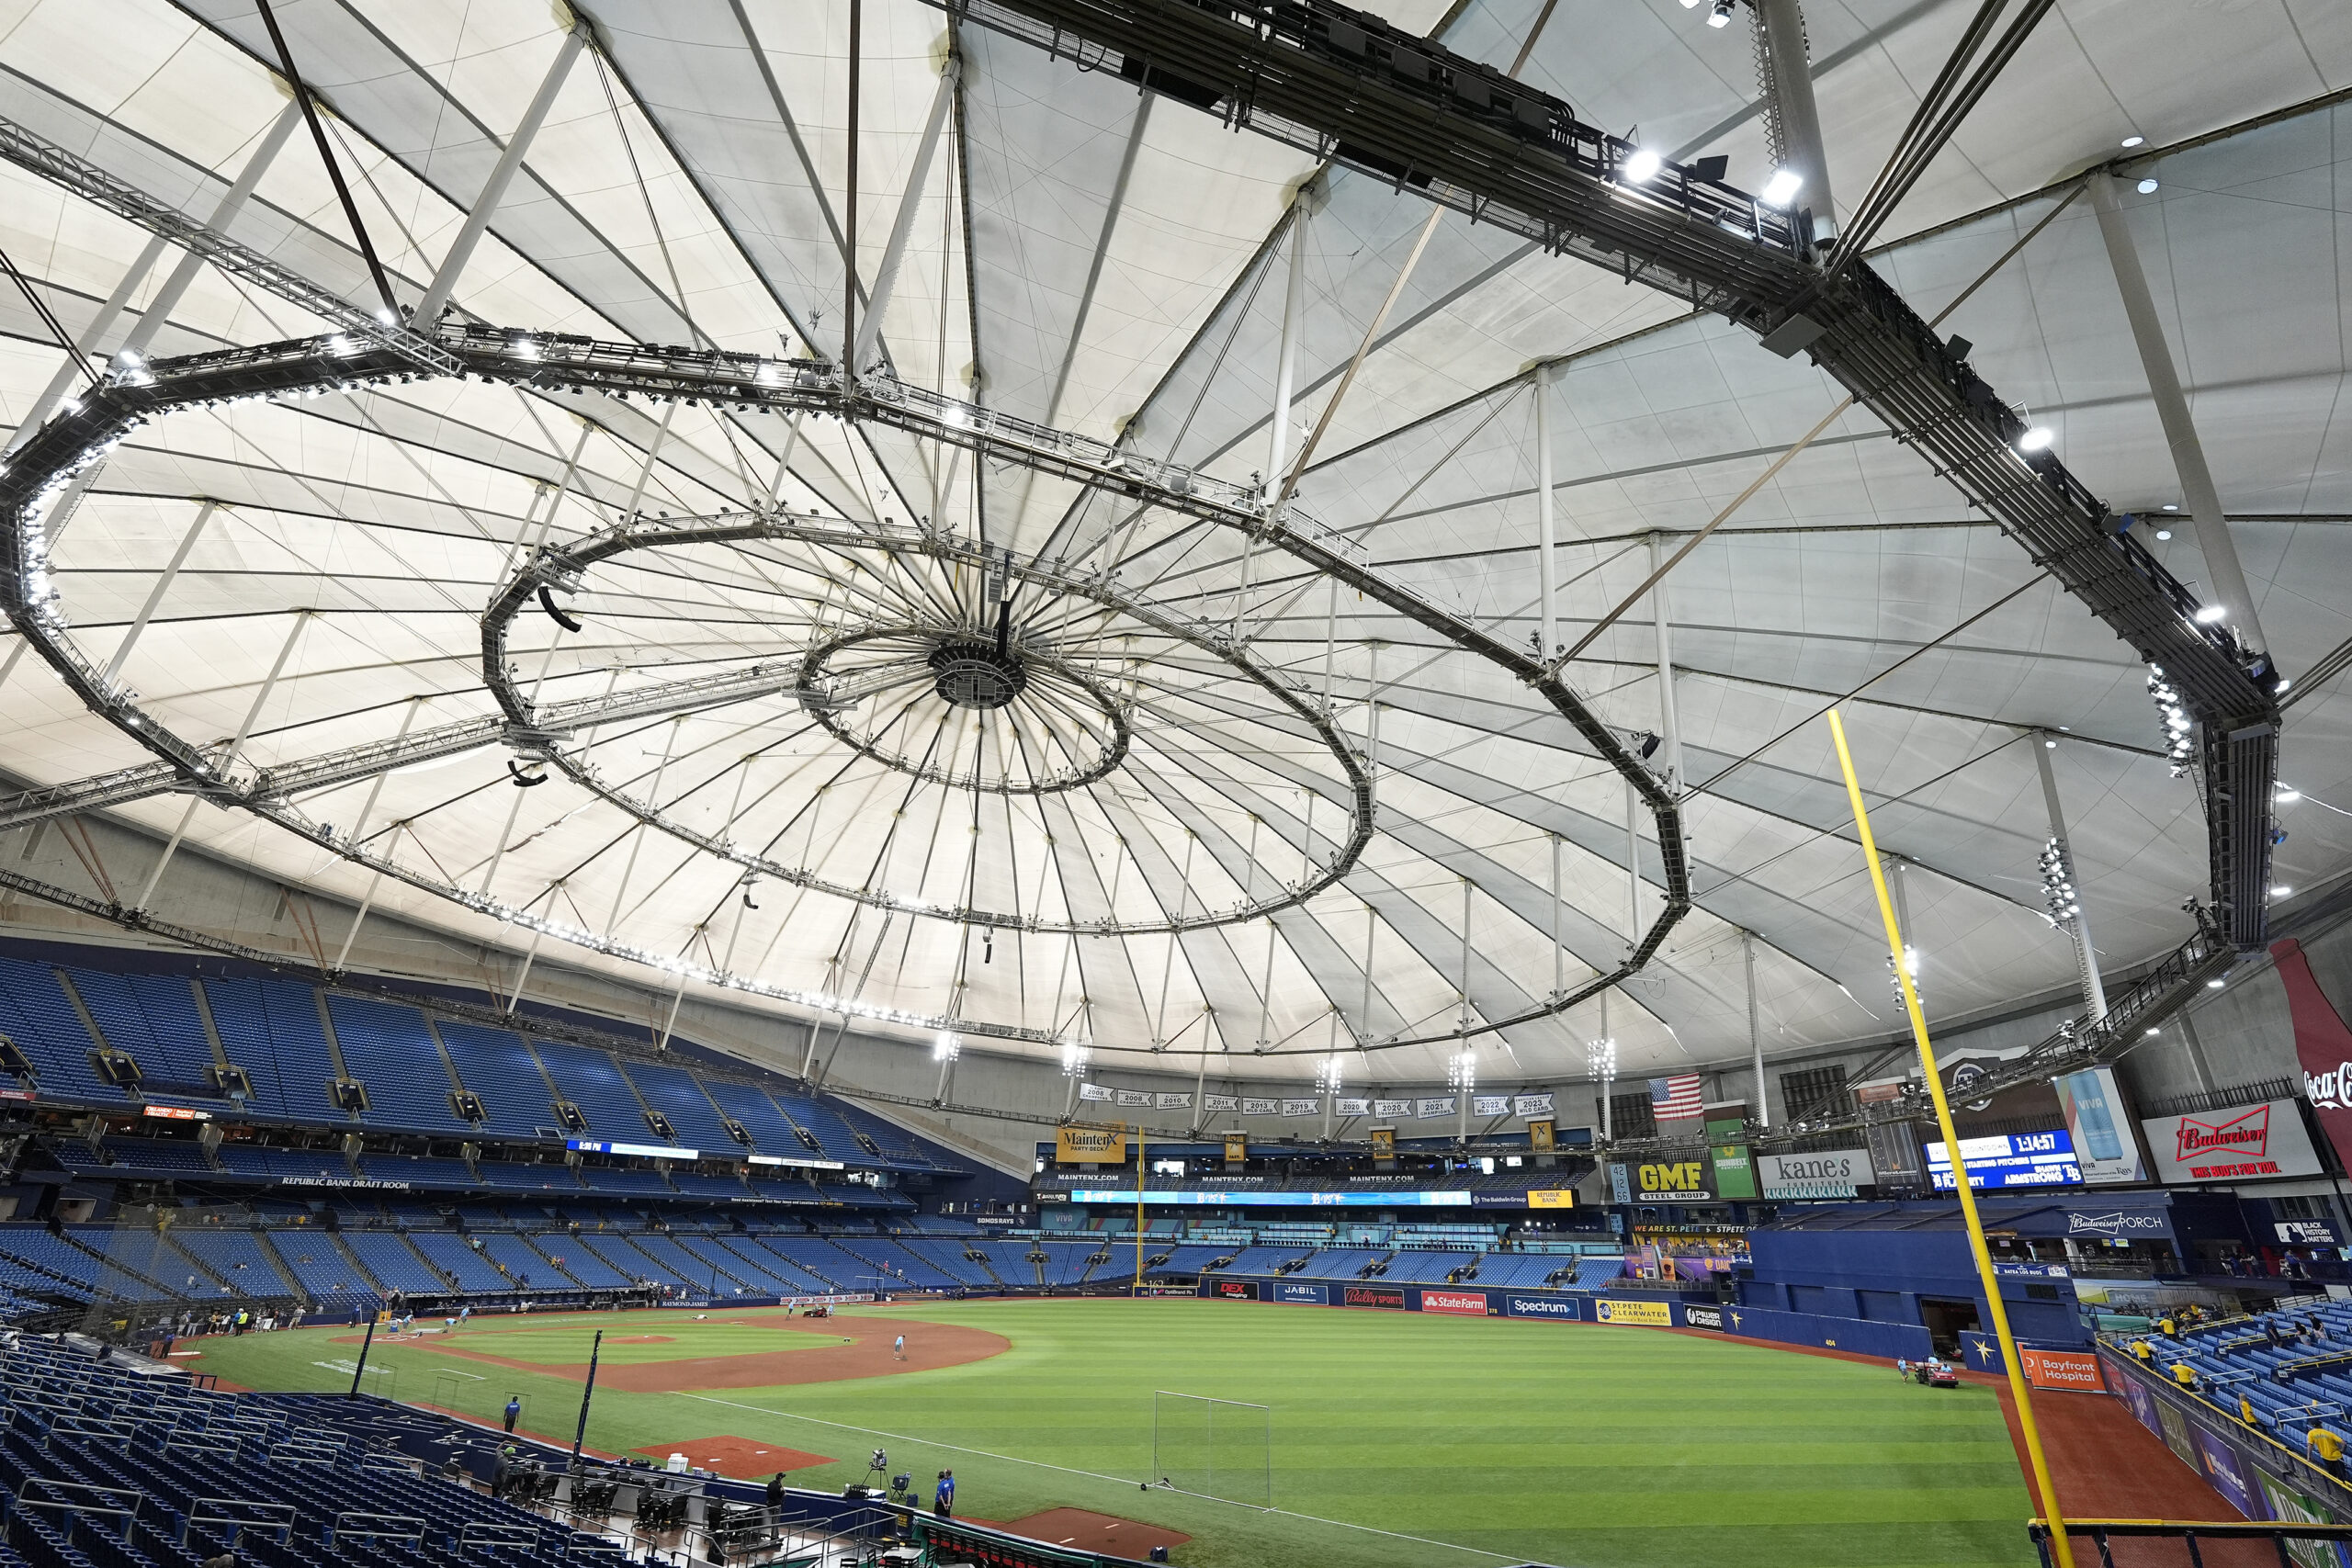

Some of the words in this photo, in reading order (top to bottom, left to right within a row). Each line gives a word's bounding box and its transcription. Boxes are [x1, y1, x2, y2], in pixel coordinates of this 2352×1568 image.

[2304, 1061, 2352, 1110] Coca-C
[1523, 1100, 1542, 1108] 2023
[2078, 1098, 2103, 1110] VIVA
[1064, 1132, 1120, 1146] MaintenX
[2016, 1134, 2055, 1152] 1:14:57
[2177, 1126, 2267, 1150] Budweiser
[593, 1143, 602, 1151] PM
[1715, 1157, 1747, 1168] SUNBELT
[1775, 1157, 1850, 1179] kane's
[1966, 1159, 1996, 1168] STARTING
[1997, 1156, 2030, 1167] PITCHERS
[1613, 1167, 1623, 1176] 42
[2034, 1165, 2062, 1173] SHAWN
[2188, 1167, 2211, 1178] THIS
[2211, 1165, 2238, 1177] BUD'S
[2238, 1163, 2256, 1176] FOR
[2256, 1161, 2281, 1174] YOU.
[1639, 1162, 1702, 1190] GMF
[2005, 1172, 2064, 1185] ARMSTRONG
[282, 1177, 324, 1186] REPUBLIC
[326, 1179, 351, 1187] BANK
[352, 1180, 381, 1189] DRAFT
[1617, 1179, 1624, 1188] 12
[1617, 1192, 1628, 1201] 66
[2070, 1218, 2120, 1228] Budweiser
[2120, 1217, 2163, 1228] PORCH
[1220, 1282, 1245, 1293] DEX
[1284, 1286, 1316, 1295] JABIL
[1346, 1289, 1378, 1306] Bally
[1378, 1295, 1402, 1304] SPORTS
[2115, 1294, 2148, 1303] HOME
[1515, 1300, 1566, 1314] Spectrum
[2042, 1359, 2095, 1371] Bayfront
[2045, 1370, 2095, 1382] Hospital
